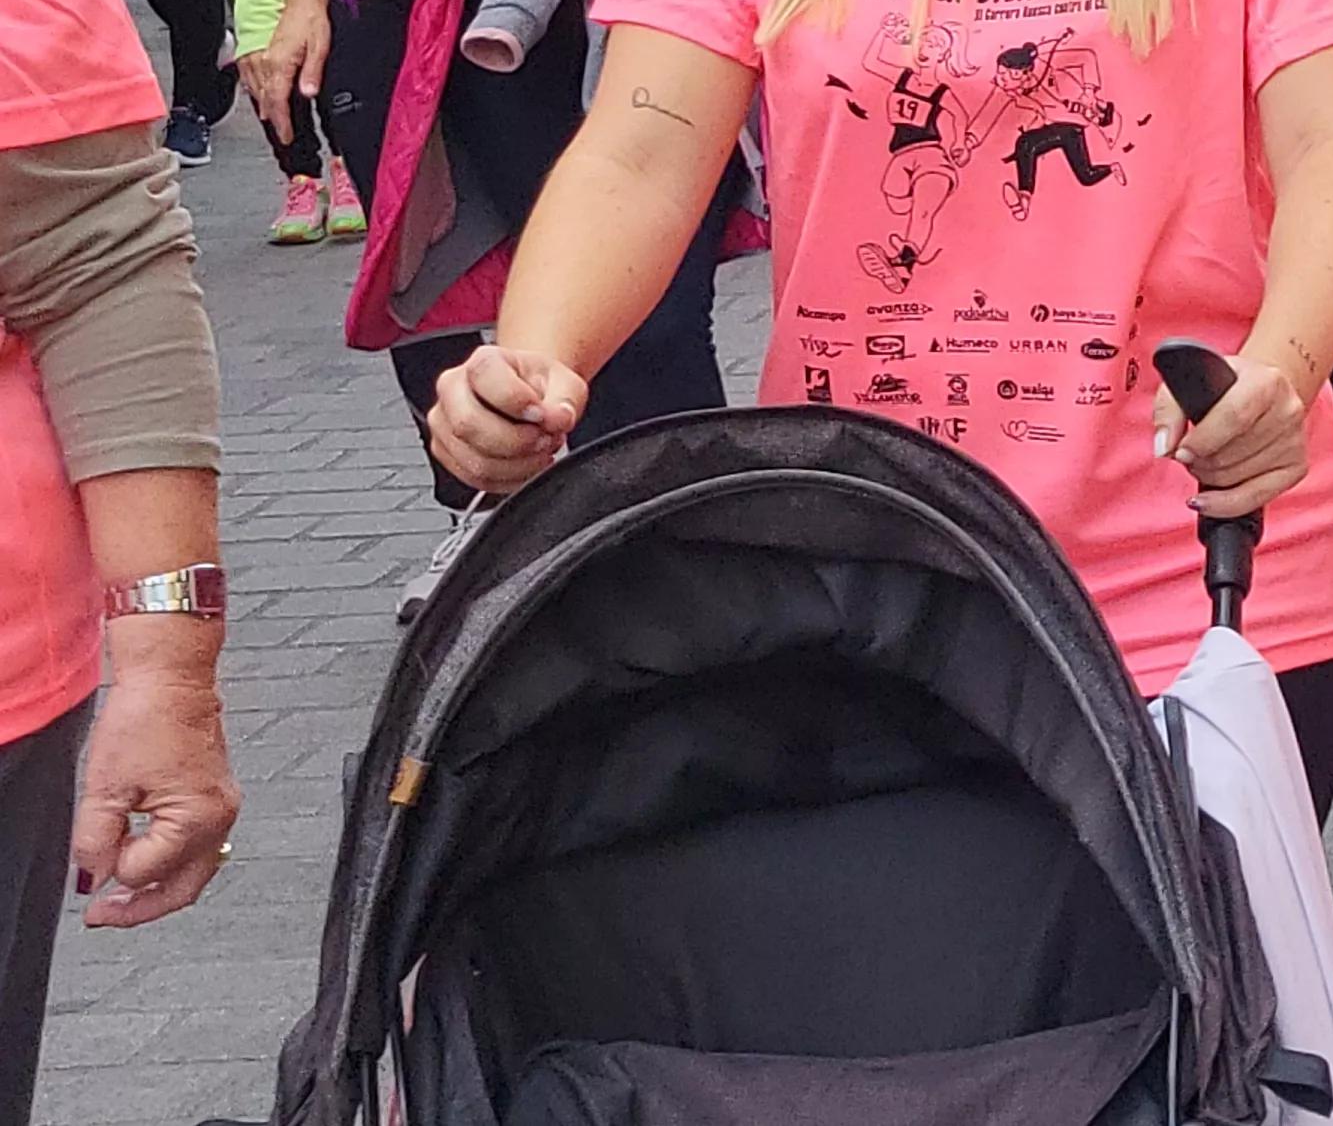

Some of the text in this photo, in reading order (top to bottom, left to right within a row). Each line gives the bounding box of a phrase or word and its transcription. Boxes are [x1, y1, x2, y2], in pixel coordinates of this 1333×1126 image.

[985, 8, 1020, 21] Carrera
[1022, 5, 1052, 18] Huesca
[1054, 1, 1082, 15] contra
[895, 99, 918, 121] 19
[796, 305, 846, 323] Alcampo
[866, 302, 919, 315] avanza
[946, 336, 999, 349] Humeco
[1009, 340, 1068, 350] URBAN
